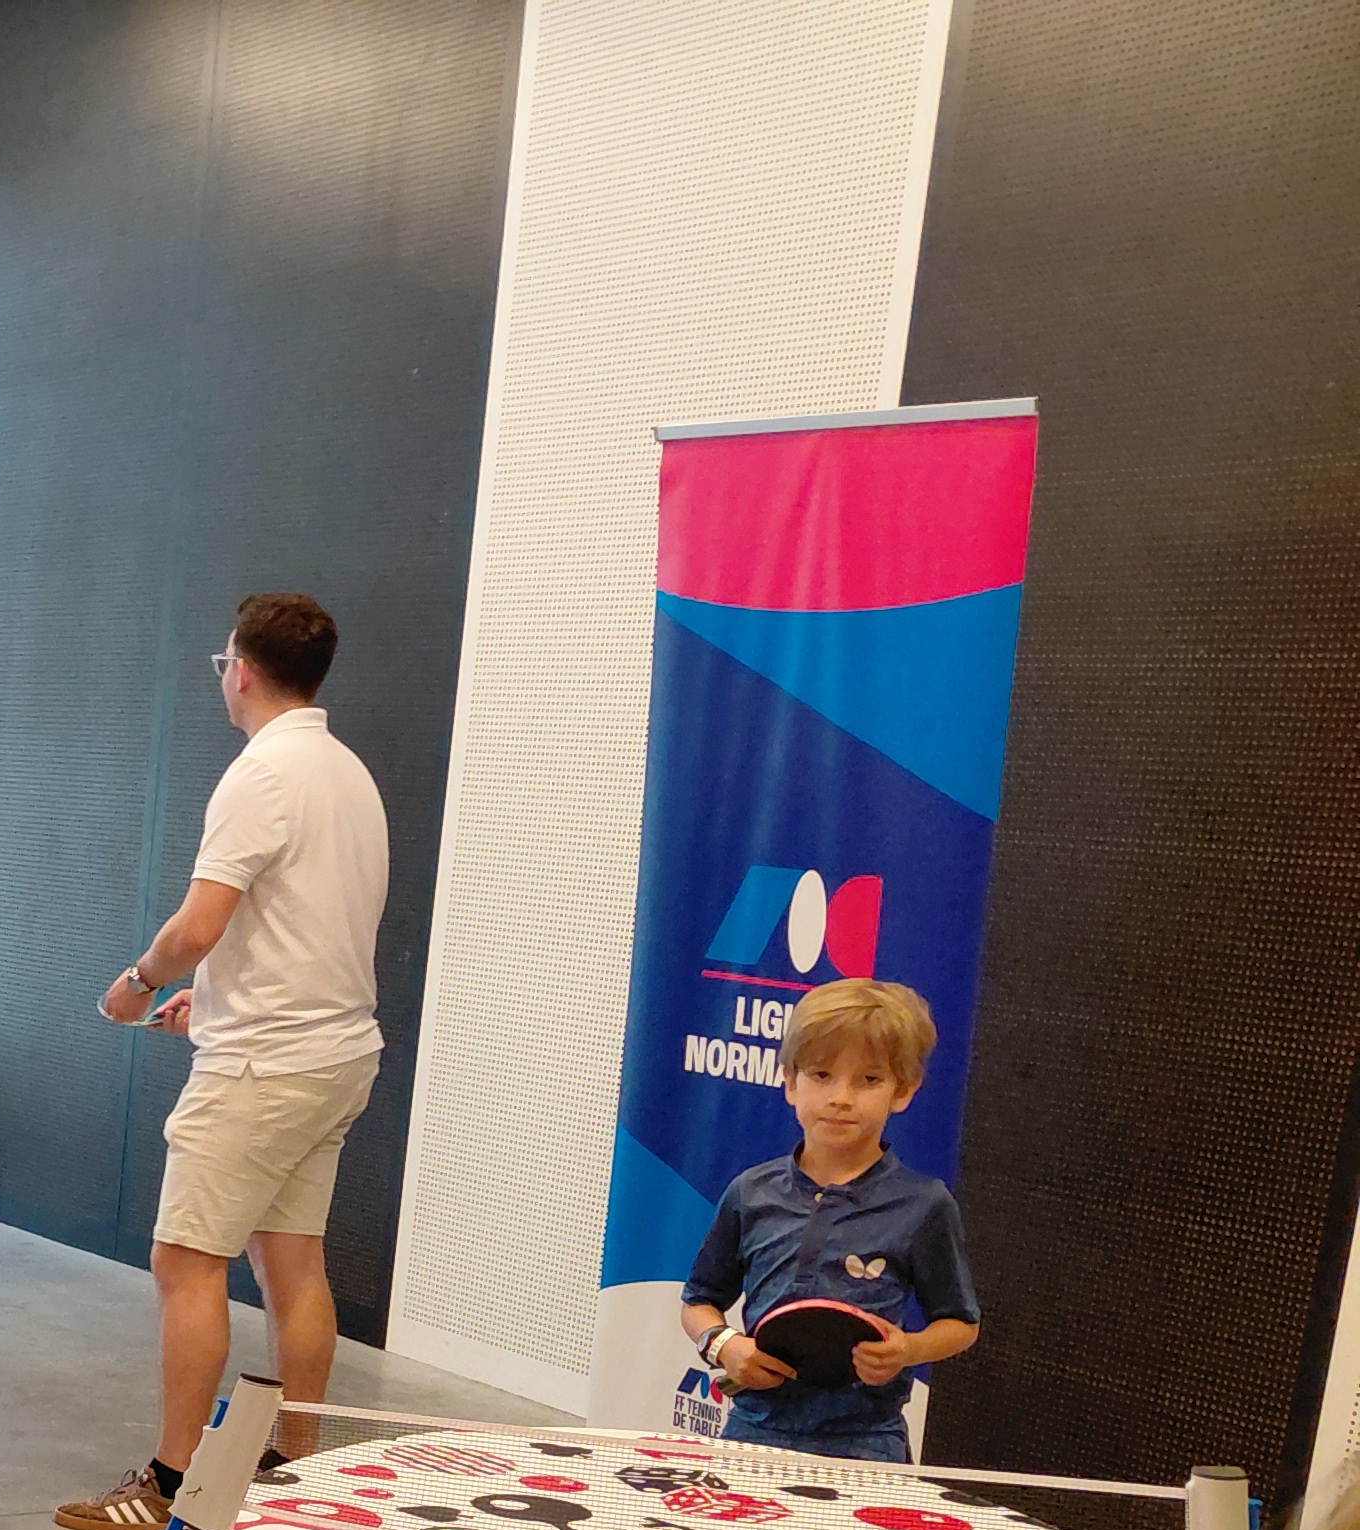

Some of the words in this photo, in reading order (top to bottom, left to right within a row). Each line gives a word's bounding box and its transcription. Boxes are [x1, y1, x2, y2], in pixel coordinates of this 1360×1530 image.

[687, 1398, 722, 1424] TENNIS
[672, 1411, 688, 1429] DE
[688, 1415, 722, 1438] TABLE
